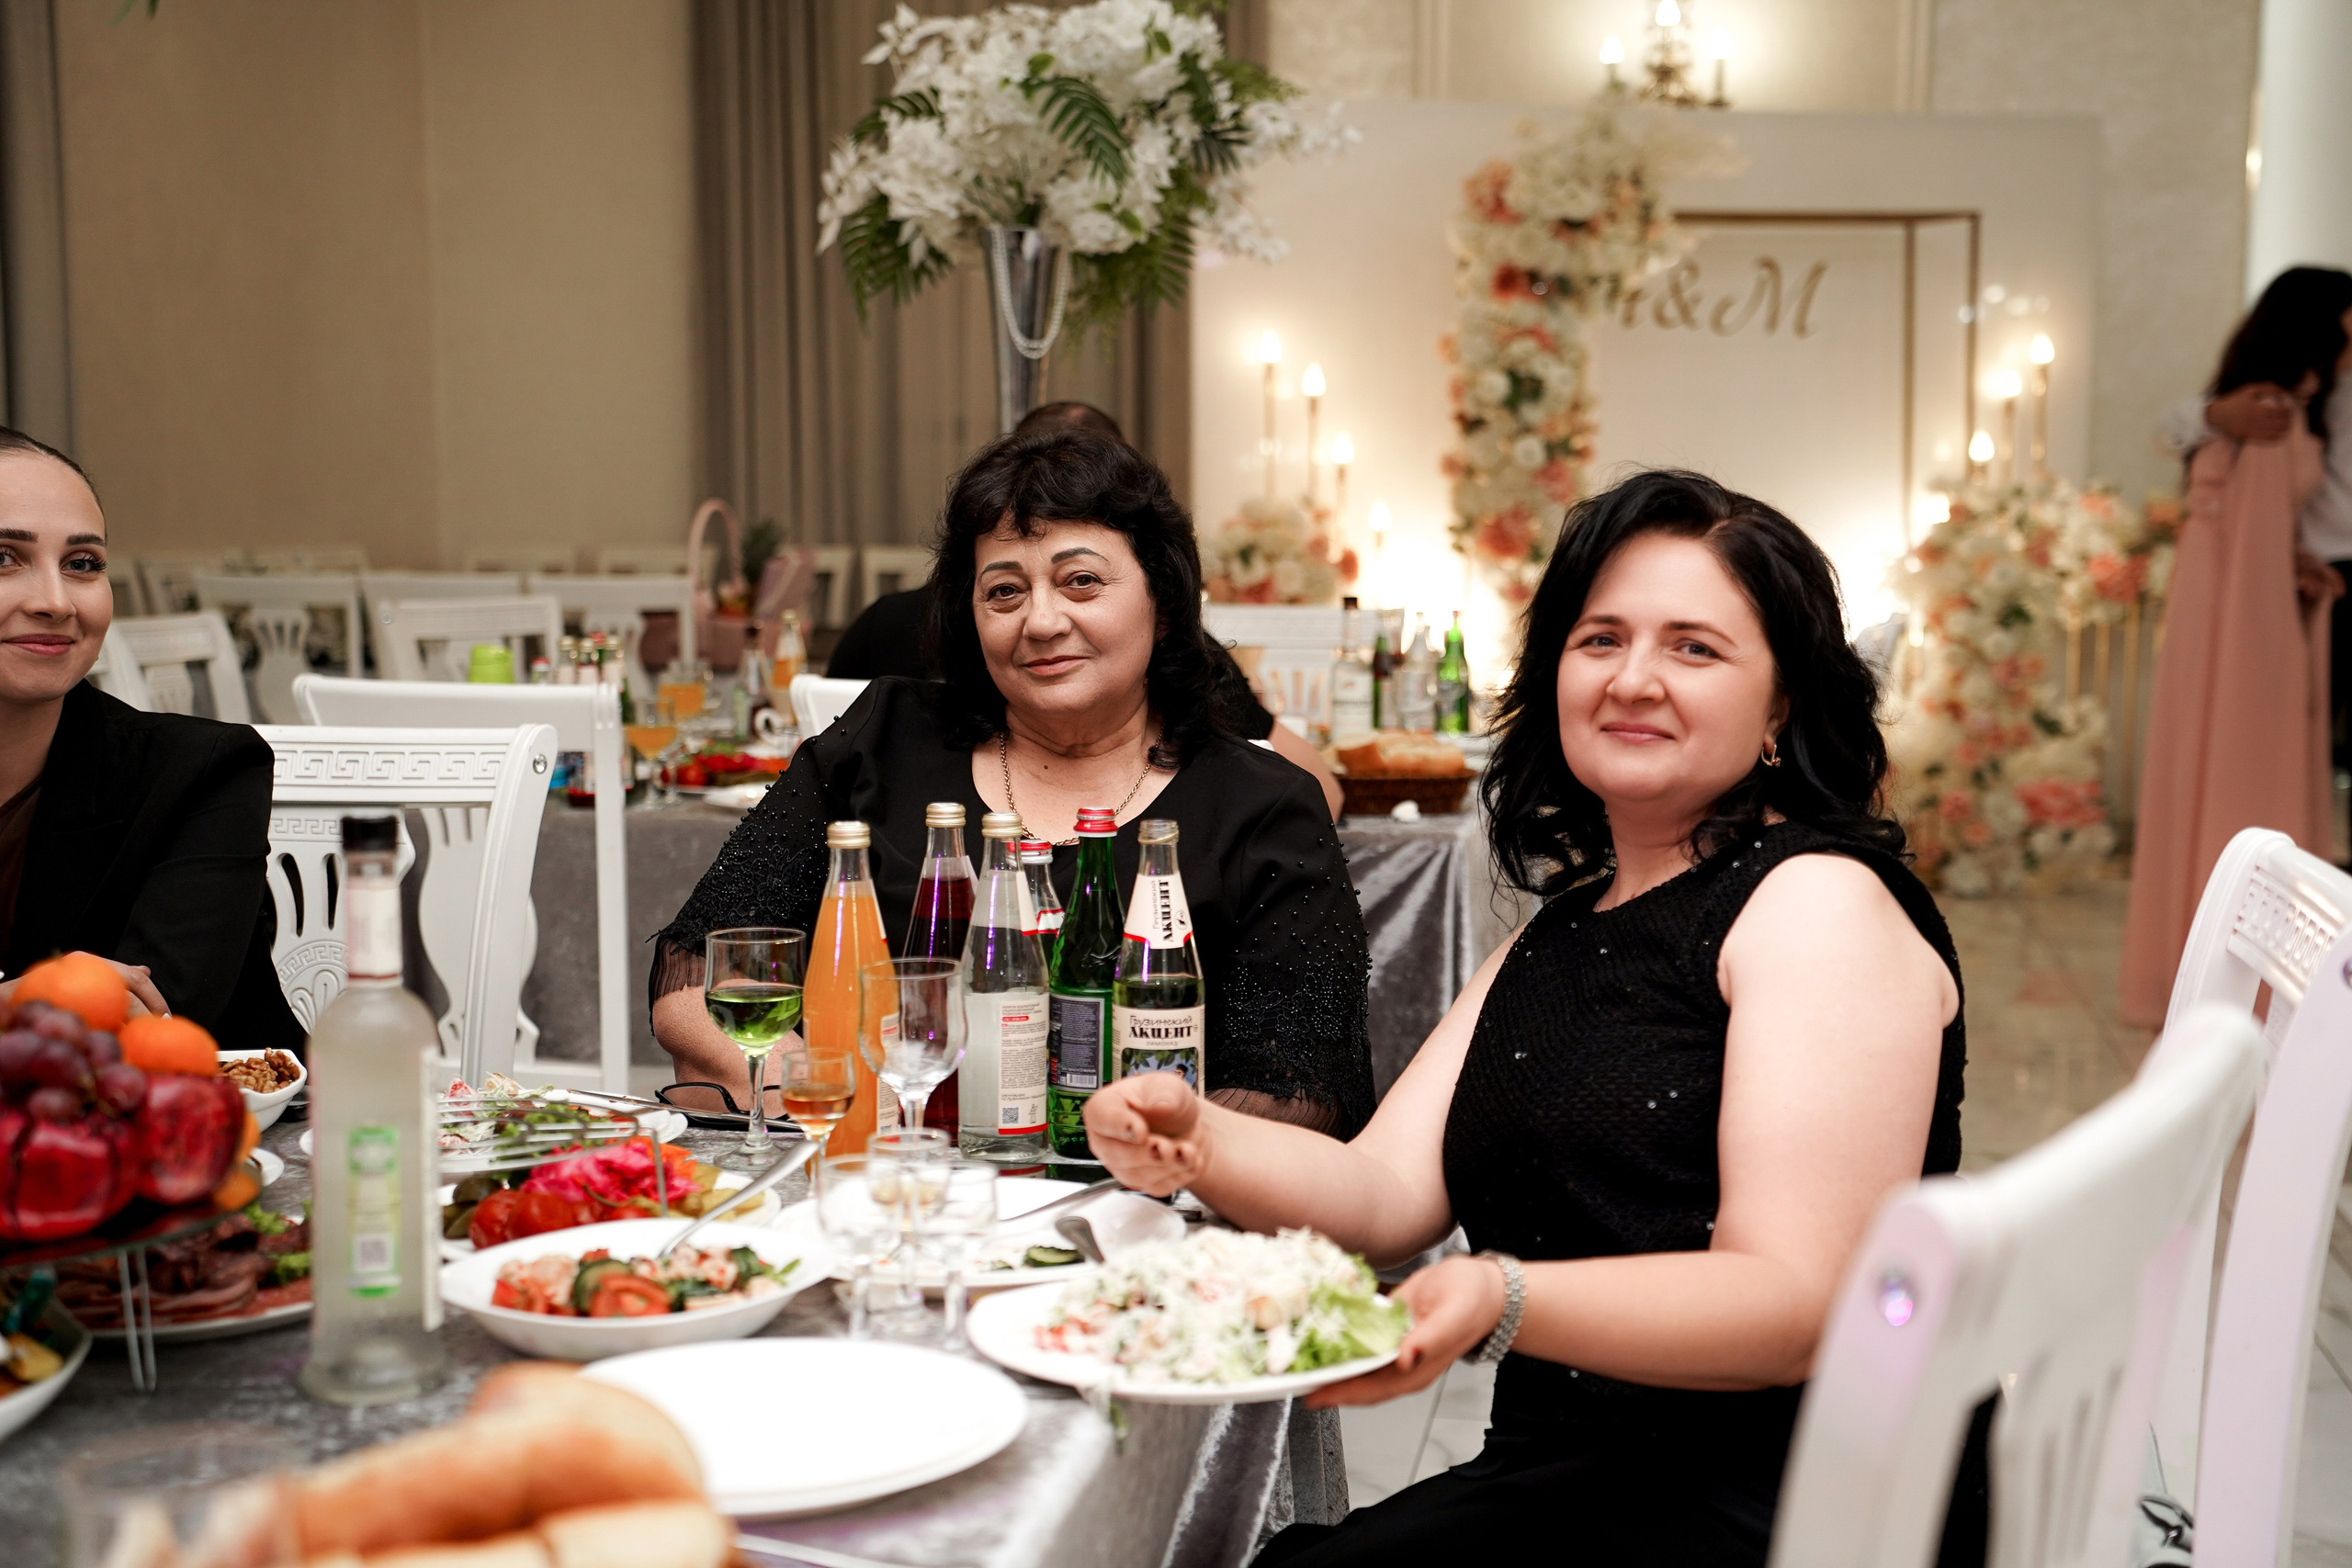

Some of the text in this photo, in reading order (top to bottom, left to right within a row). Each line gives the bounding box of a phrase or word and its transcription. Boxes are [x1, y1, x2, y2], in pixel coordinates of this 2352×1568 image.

[1159, 879, 1174, 943] АКЦЕНТ
[1129, 1014, 1193, 1028] Грузинский
[1128, 1025, 1193, 1041] АКЦЕНТ
